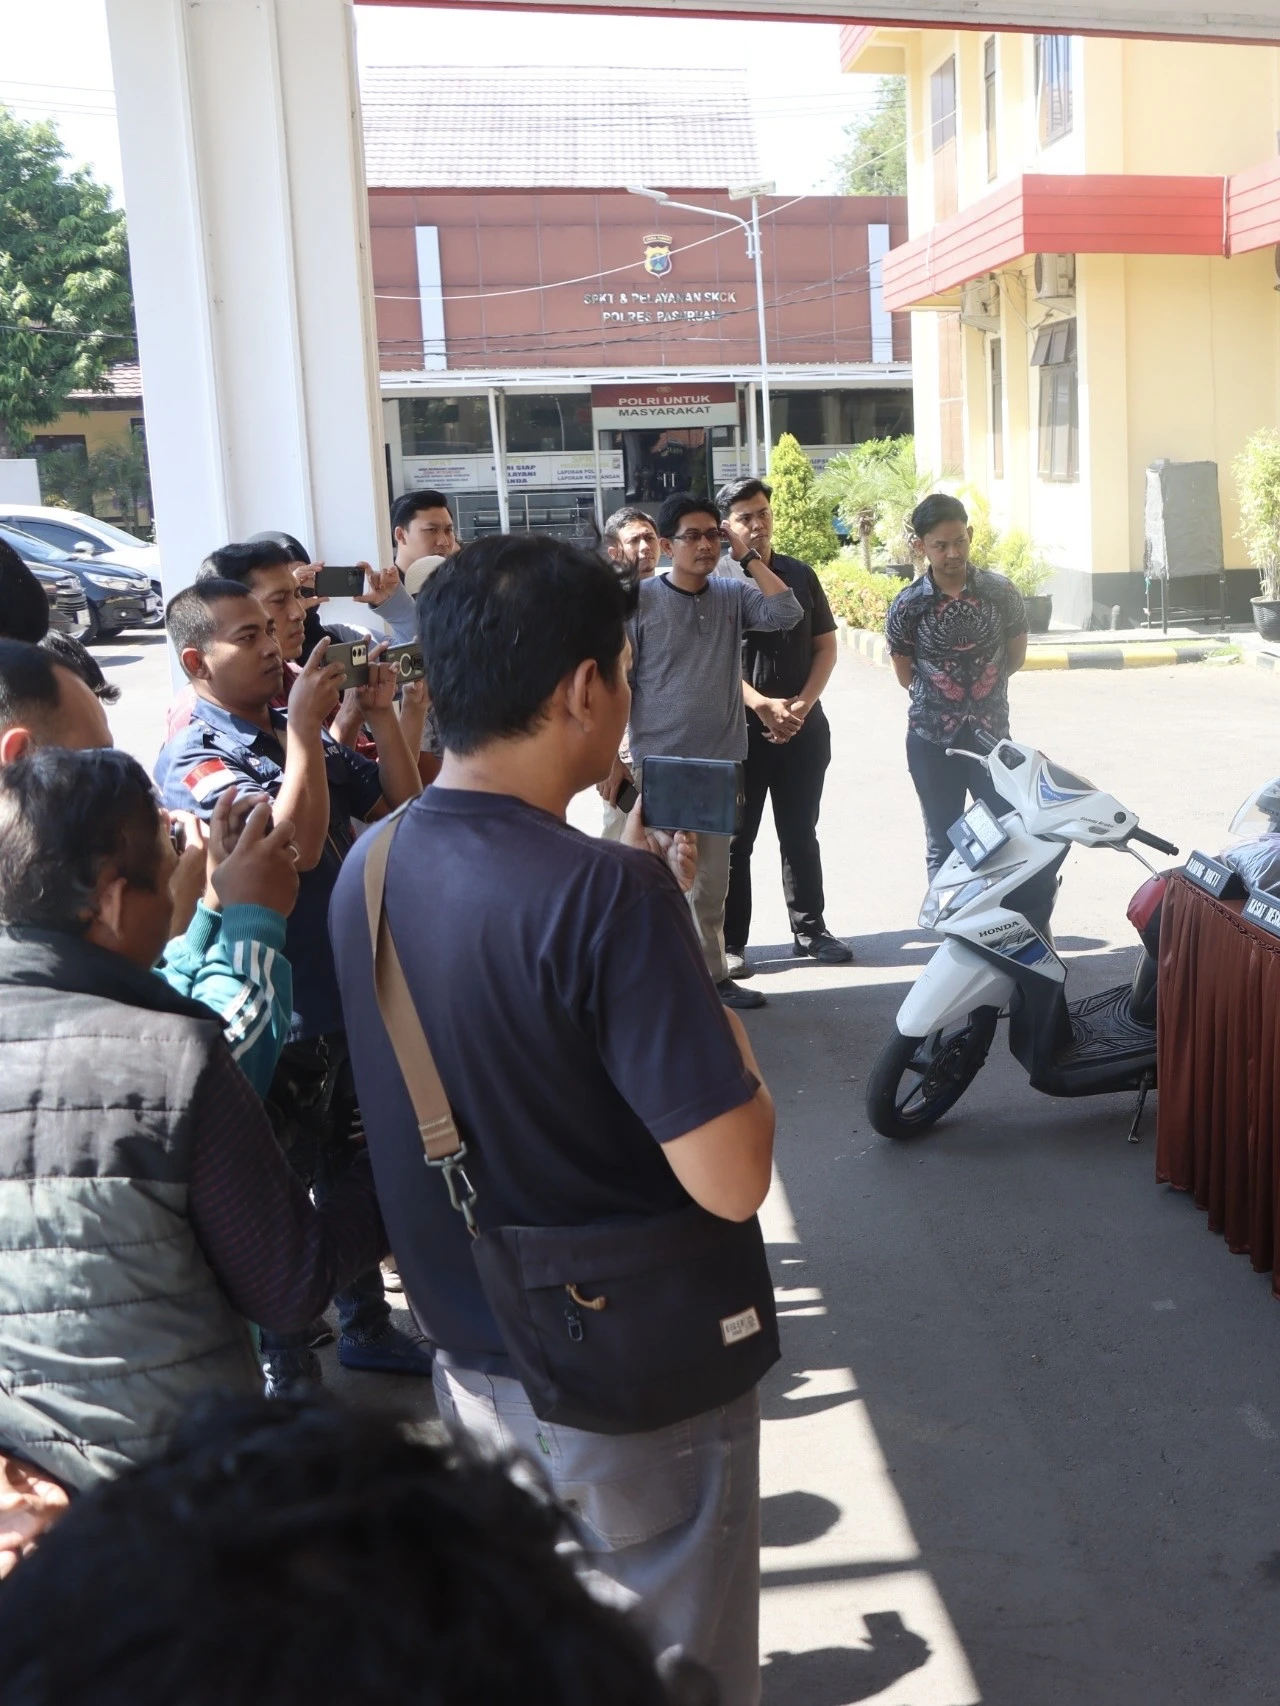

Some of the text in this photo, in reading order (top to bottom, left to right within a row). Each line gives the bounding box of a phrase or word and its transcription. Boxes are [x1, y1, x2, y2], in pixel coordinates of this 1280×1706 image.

[583, 291, 736, 304] SPKT & PELAYANAN SKCK
[603, 311, 652, 322] POLRES
[618, 395, 710, 406] POLRI UNTUK
[618, 406, 711, 416] MASYARAKAT
[1246, 898, 1268, 919] KASAT
[978, 920, 1020, 938] HONDA
